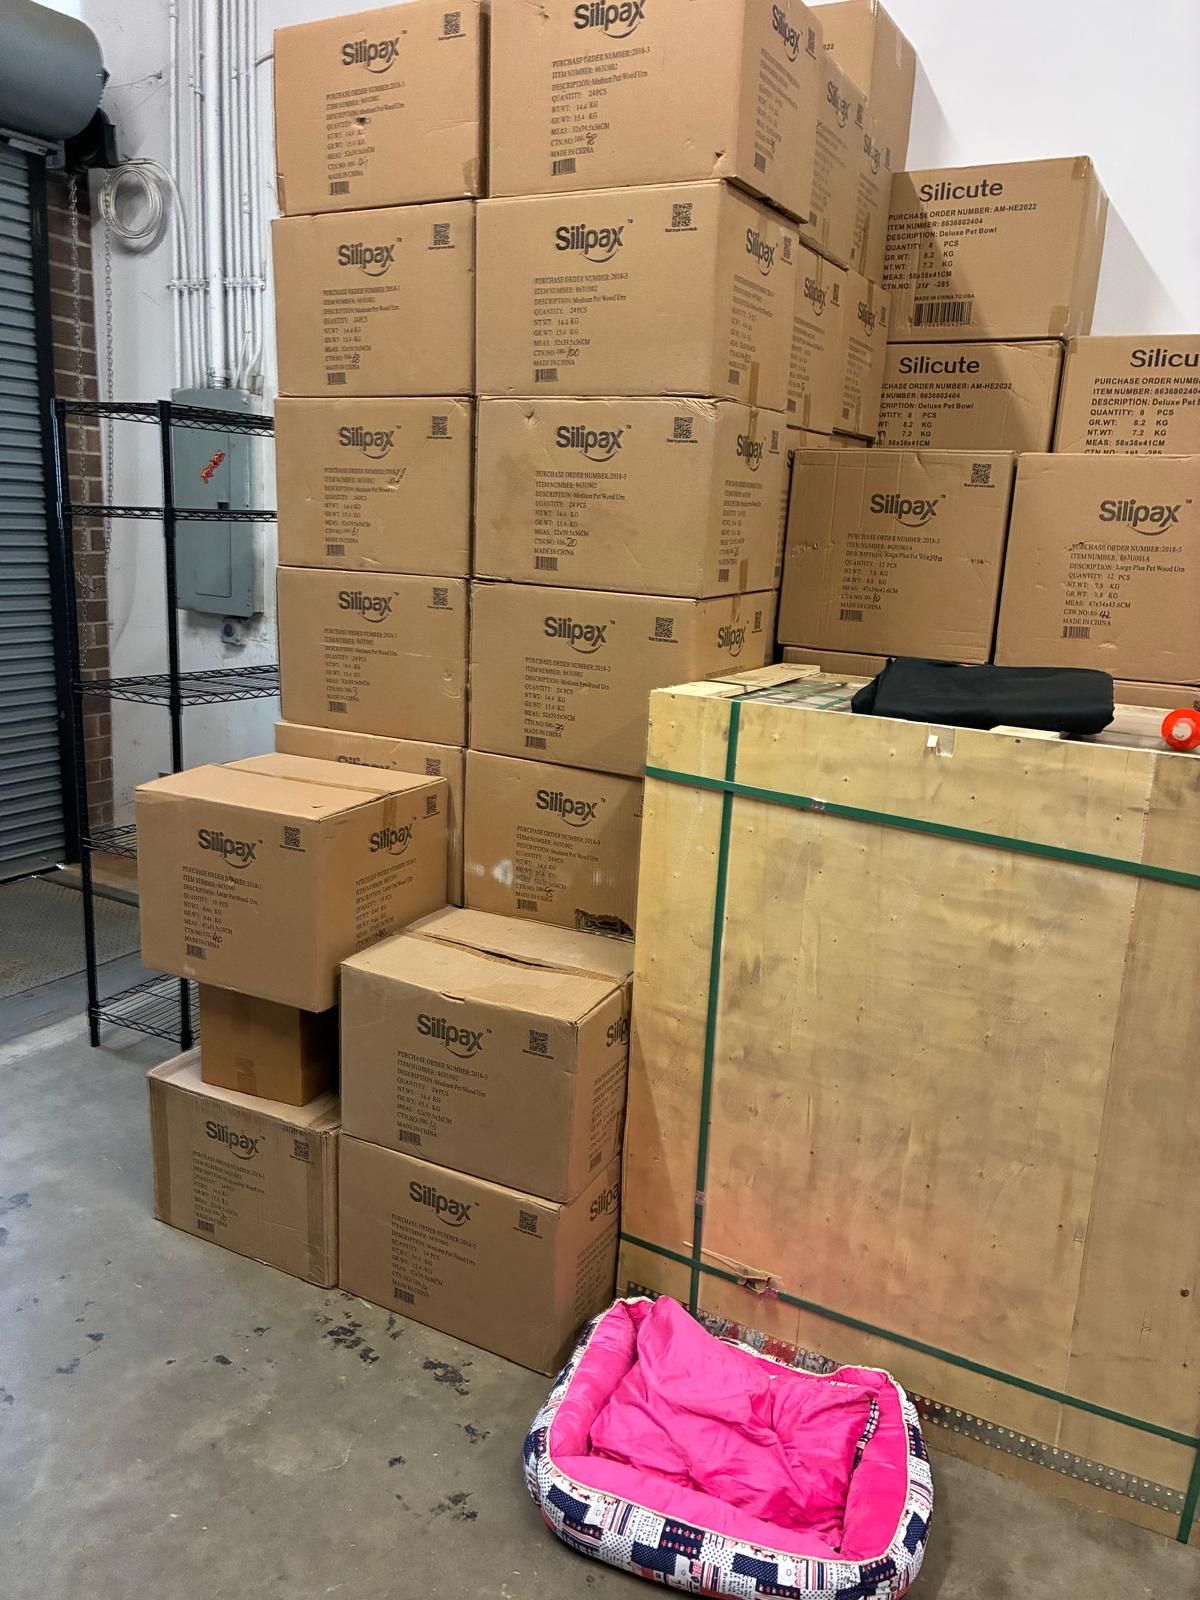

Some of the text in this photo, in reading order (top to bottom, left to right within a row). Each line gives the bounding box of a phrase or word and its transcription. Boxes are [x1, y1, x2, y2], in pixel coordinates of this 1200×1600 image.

[574, 0, 646, 31] Silipax
[342, 37, 400, 67] Silipax
[919, 179, 1003, 202] Silicute
[888, 203, 1037, 220] PURCHASE ORDER NUMBER: AM-HE2022
[555, 223, 624, 255] Silipax
[886, 226, 997, 242] DESCRIPTION: Deluxe Pet Bowl
[887, 223, 905, 231] ITEM
[905, 221, 940, 230] NUMBER:
[338, 242, 395, 269] Silipax
[746, 228, 775, 268] Silipax
[885, 243, 923, 252] QUANTITY:
[882, 273, 905, 281] MEAS:
[942, 260, 953, 268] KG
[899, 356, 980, 374] Silicute
[908, 382, 934, 390] ORDER
[935, 382, 970, 390] NUMBER:
[971, 382, 1012, 390] AM-HE2022
[1094, 377, 1140, 385] PURCHASE
[1091, 398, 1196, 406] DESCRIPTION: Deluxe Pet
[339, 426, 396, 452] Silipax
[556, 425, 624, 454] Silipax
[736, 433, 764, 466] Silipax
[870, 493, 939, 520] Silipax
[1099, 499, 1182, 527] Silipax
[1069, 562, 1114, 570] DESCRIPTION:
[1115, 564, 1132, 572] Large
[1087, 553, 1117, 561] NUMBER:
[1068, 572, 1102, 580] QUANTITY:
[338, 590, 392, 616] Silipax
[544, 616, 607, 647] Silipax
[718, 626, 746, 651] Silipax
[536, 789, 598, 821] Silipax
[198, 828, 257, 863] Silipax
[369, 823, 413, 853] Silipax
[417, 1013, 484, 1052] Silipax
[205, 1120, 259, 1155] Silipax
[409, 1181, 471, 1221] Silipax
